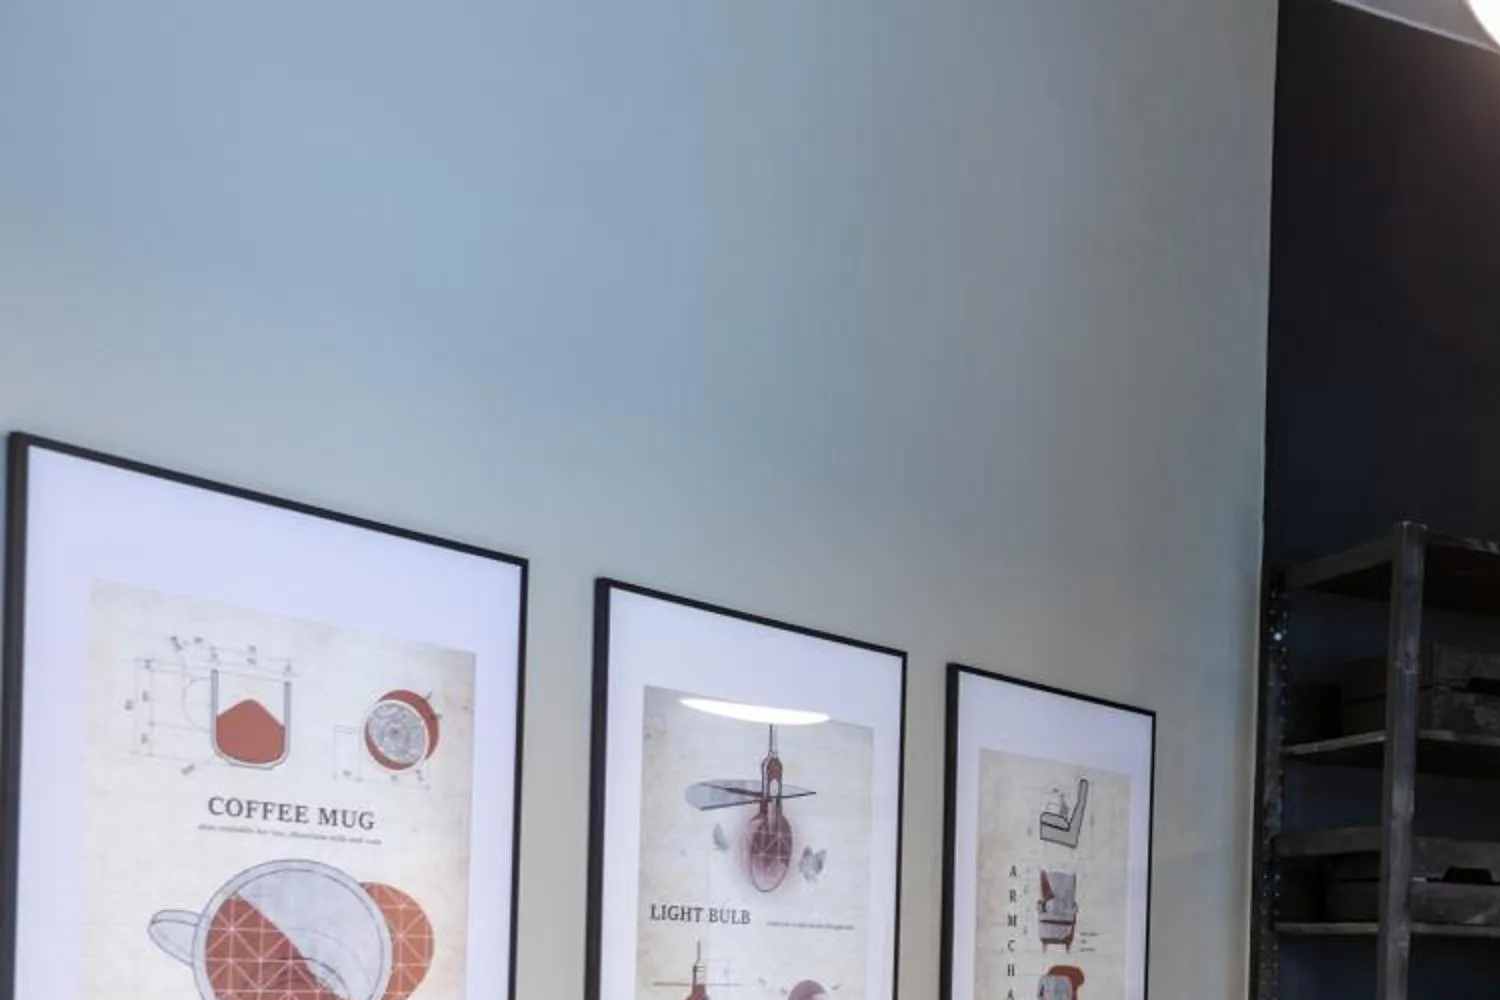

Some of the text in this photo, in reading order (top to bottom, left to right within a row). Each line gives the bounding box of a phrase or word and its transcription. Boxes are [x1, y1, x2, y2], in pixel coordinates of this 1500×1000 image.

[208, 796, 376, 831] COFFEE MUG
[650, 904, 751, 925] LIGHT BULB
